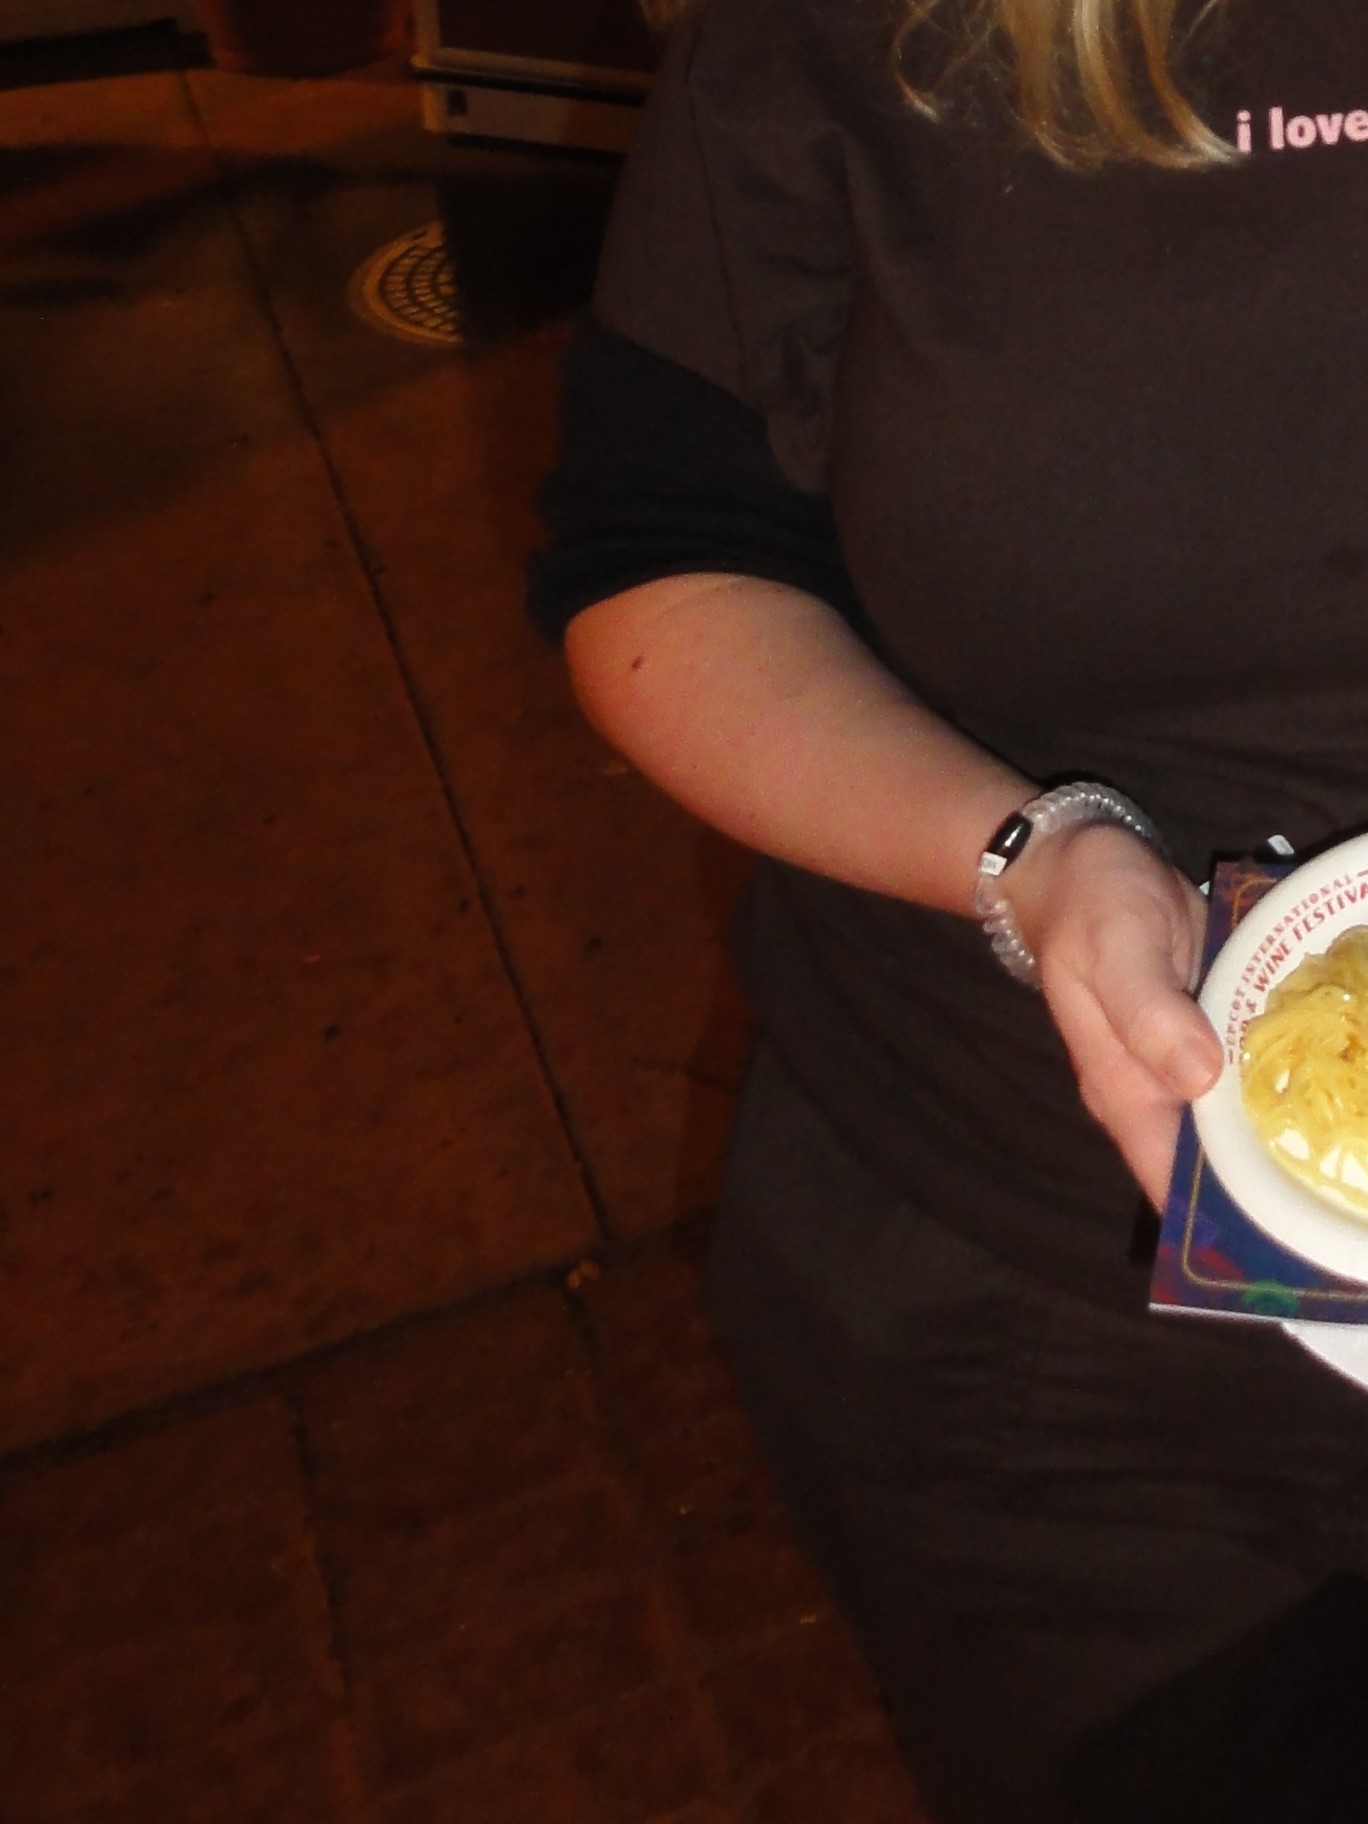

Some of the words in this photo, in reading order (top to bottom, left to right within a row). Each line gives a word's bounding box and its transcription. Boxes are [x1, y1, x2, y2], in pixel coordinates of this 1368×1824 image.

[1237, 110, 1252, 153] i
[1226, 986, 1246, 1045] EPCOT
[1241, 873, 1353, 982] INTERNATIONAL
[1253, 942, 1292, 993] WINE
